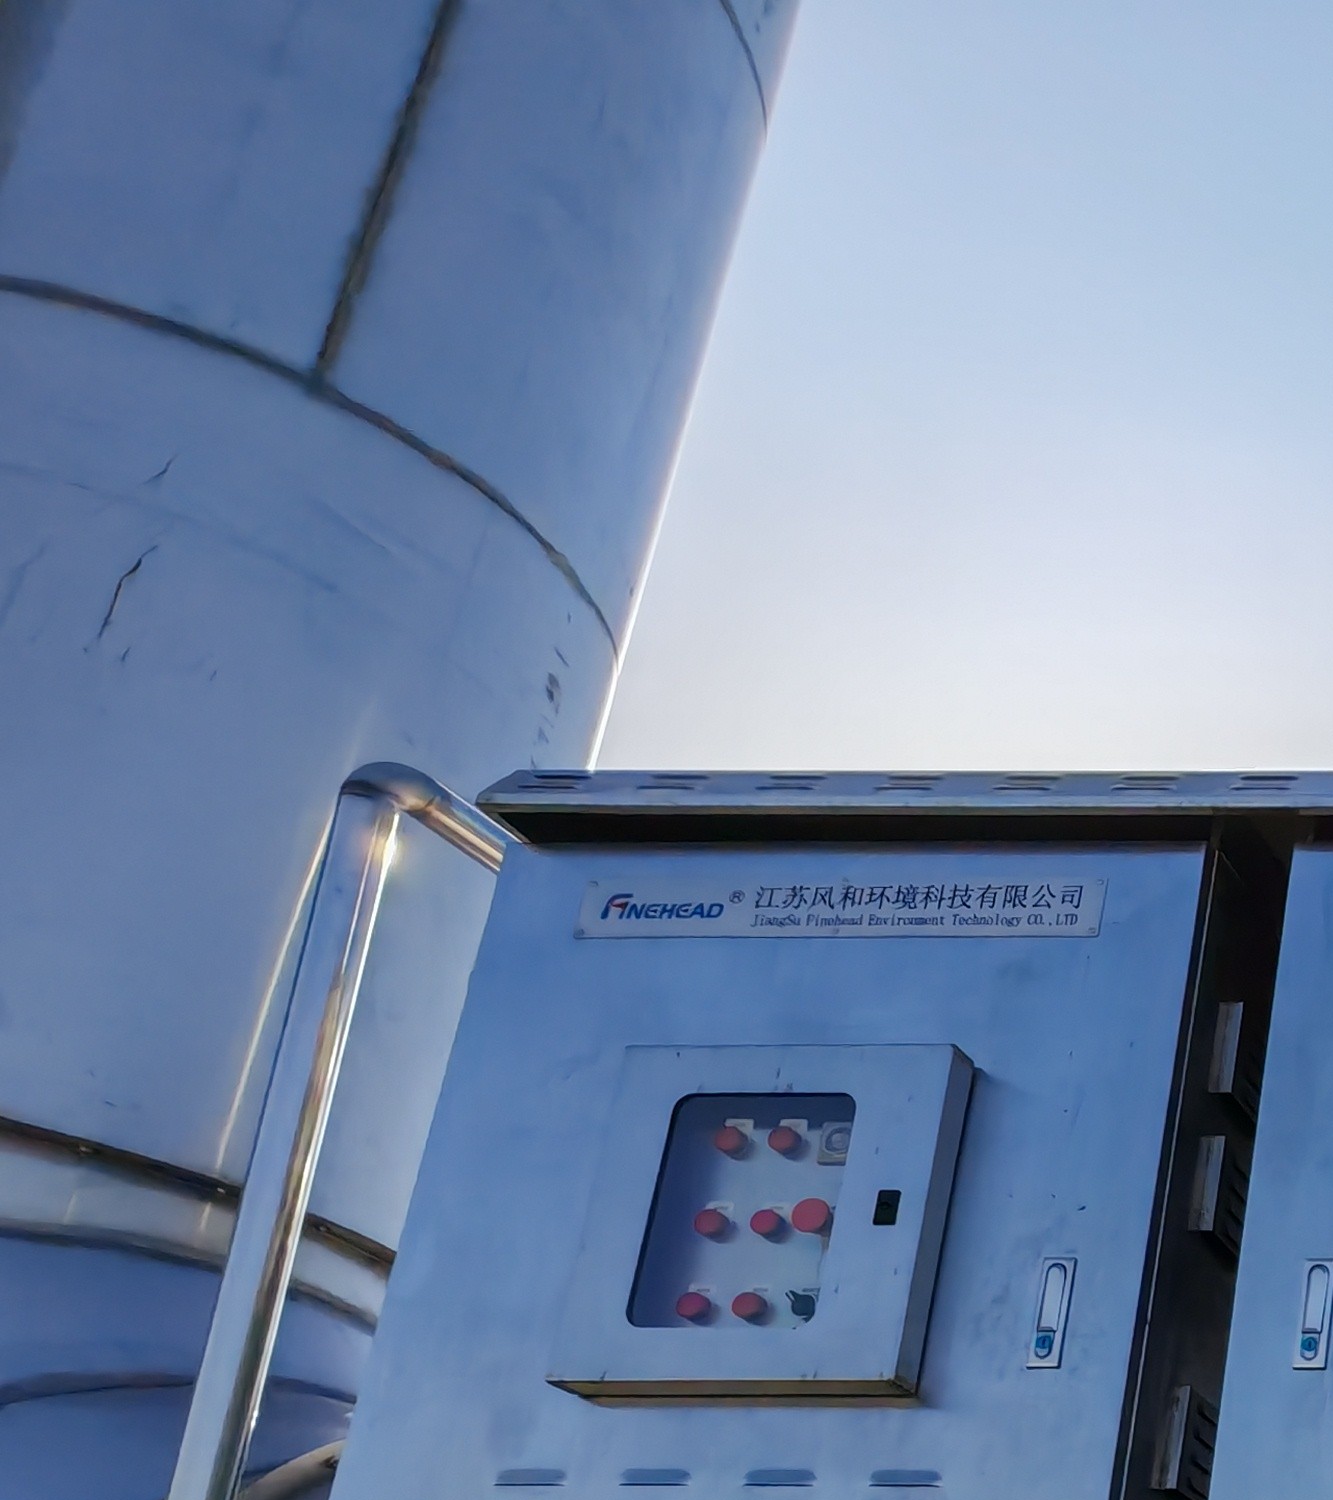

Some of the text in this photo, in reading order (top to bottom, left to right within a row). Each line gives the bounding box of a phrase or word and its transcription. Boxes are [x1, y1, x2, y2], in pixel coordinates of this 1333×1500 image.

[754, 883, 1084, 910] 江苏风和环境科技有限公司
[952, 914, 1022, 928] Technology
